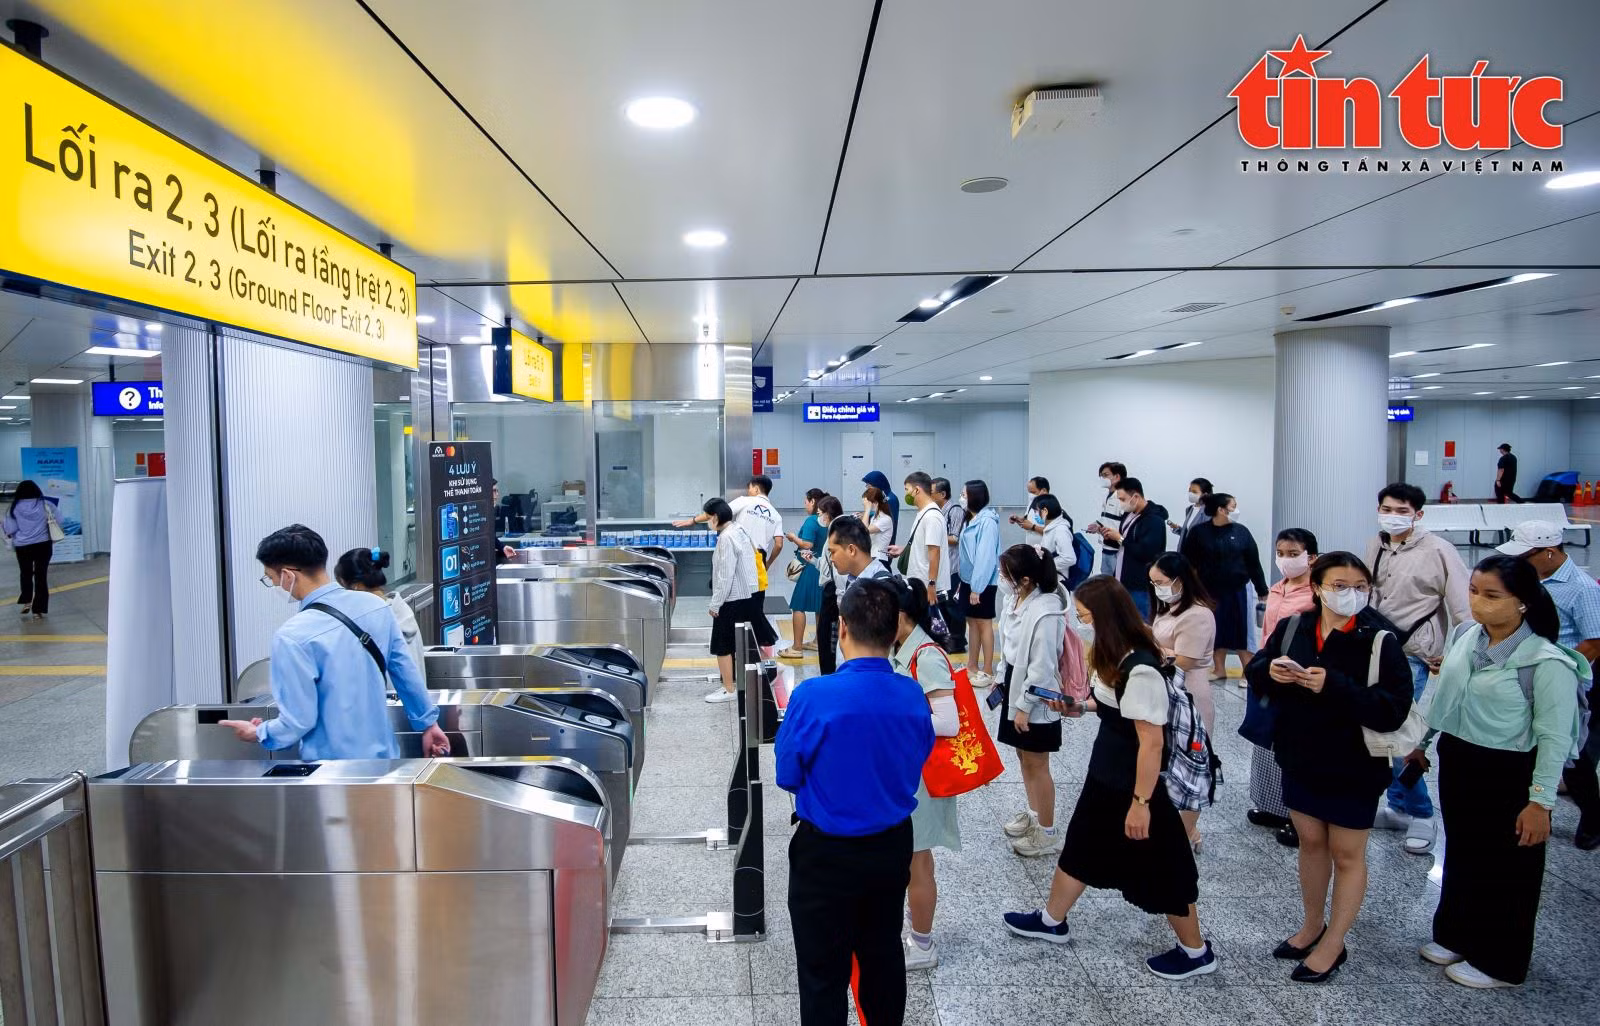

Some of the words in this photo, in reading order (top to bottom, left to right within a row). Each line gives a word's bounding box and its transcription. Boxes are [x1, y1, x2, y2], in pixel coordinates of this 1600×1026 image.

[24, 102, 97, 190] Lối
[113, 160, 153, 213] ra
[165, 173, 193, 231] 2,
[203, 192, 220, 238] 3
[230, 205, 276, 263] (Lối
[284, 240, 306, 275] ra
[312, 245, 351, 301] tầng
[355, 267, 381, 310] trệt
[385, 279, 397, 313] 2,
[399, 287, 410, 320] 3)
[128, 228, 176, 278] Exit
[184, 250, 202, 288] 2,
[209, 259, 221, 291] 3
[229, 266, 298, 314] (Ground
[302, 291, 337, 326] Floor
[340, 305, 362, 336] Exit
[364, 314, 375, 340] 2,
[376, 318, 385, 341] 3)
